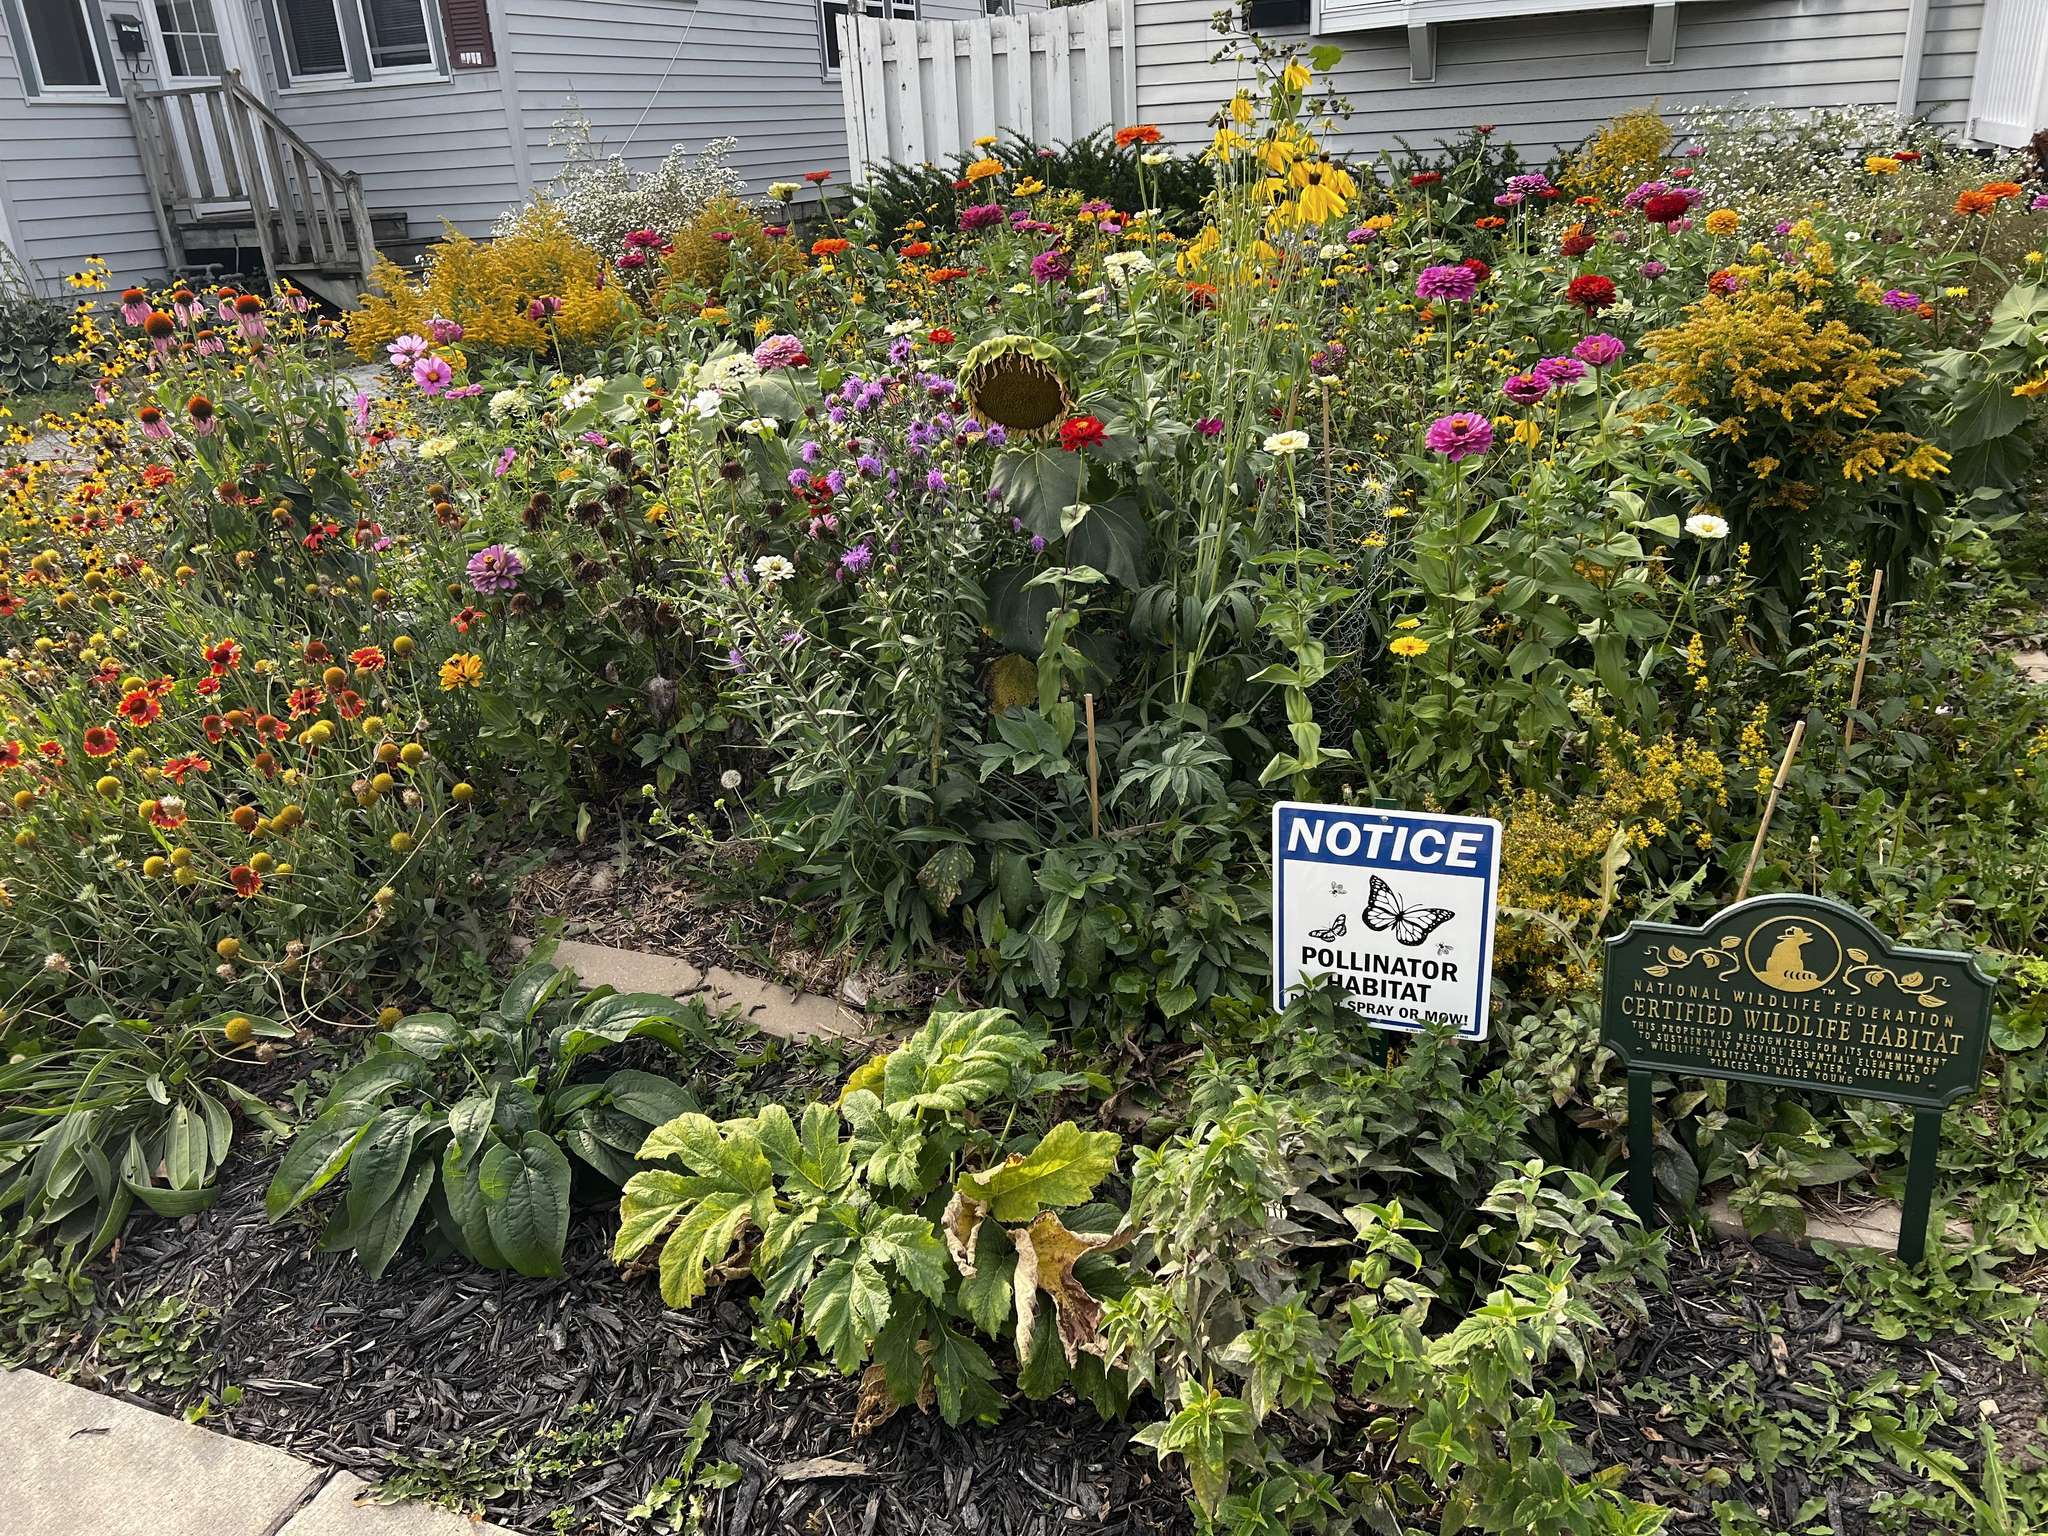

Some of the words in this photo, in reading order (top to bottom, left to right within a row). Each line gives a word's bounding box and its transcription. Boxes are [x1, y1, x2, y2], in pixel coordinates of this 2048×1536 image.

[1287, 817, 1484, 868] NOTICE
[1302, 946, 1458, 982] POLLINATOR
[1348, 1000, 1394, 1016] SPRAY
[1399, 1008, 1418, 1020] OR
[1425, 1010, 1468, 1026] MOW!
[1634, 979, 1720, 1000] NATIONAL
[1733, 990, 1821, 1012] WILDLIFE
[1834, 1002, 1954, 1028] FEDERATION
[1822, 988, 1836, 996] TM
[1622, 996, 1733, 1026] CERTIFIED
[1744, 1010, 1851, 1040] WILDLIFE
[1860, 1024, 1964, 1055] HABITAT
[1632, 1020, 1656, 1031] THIS
[1662, 1024, 1716, 1038] PROPERTY
[1721, 1031, 1732, 1040] IS
[1738, 1033, 1810, 1050] RECOGNIZED
[1816, 1043, 1838, 1053] FOR
[1844, 1046, 1862, 1056] ITS
[1869, 1050, 1948, 1066] COMMITMENT
[1638, 1030, 1651, 1040] TO
[1657, 1033, 1730, 1048] SUSTAINABLY
[1736, 1042, 1784, 1056] PROVIDE
[1790, 1049, 1851, 1065] ESSENTIAL
[1858, 1058, 1916, 1073] ELEMENTS
[1922, 1066, 1937, 1076] OF
[1650, 1041, 1701, 1056] WILDLIFE
[1854, 1067, 1890, 1080] COVER
[1896, 1072, 1921, 1084] AND
[1711, 1058, 1749, 1071] PLACES
[1755, 1064, 1768, 1073] TO
[1775, 1066, 1808, 1078] RAISE
[1814, 1071, 1854, 1084] YOUNG
